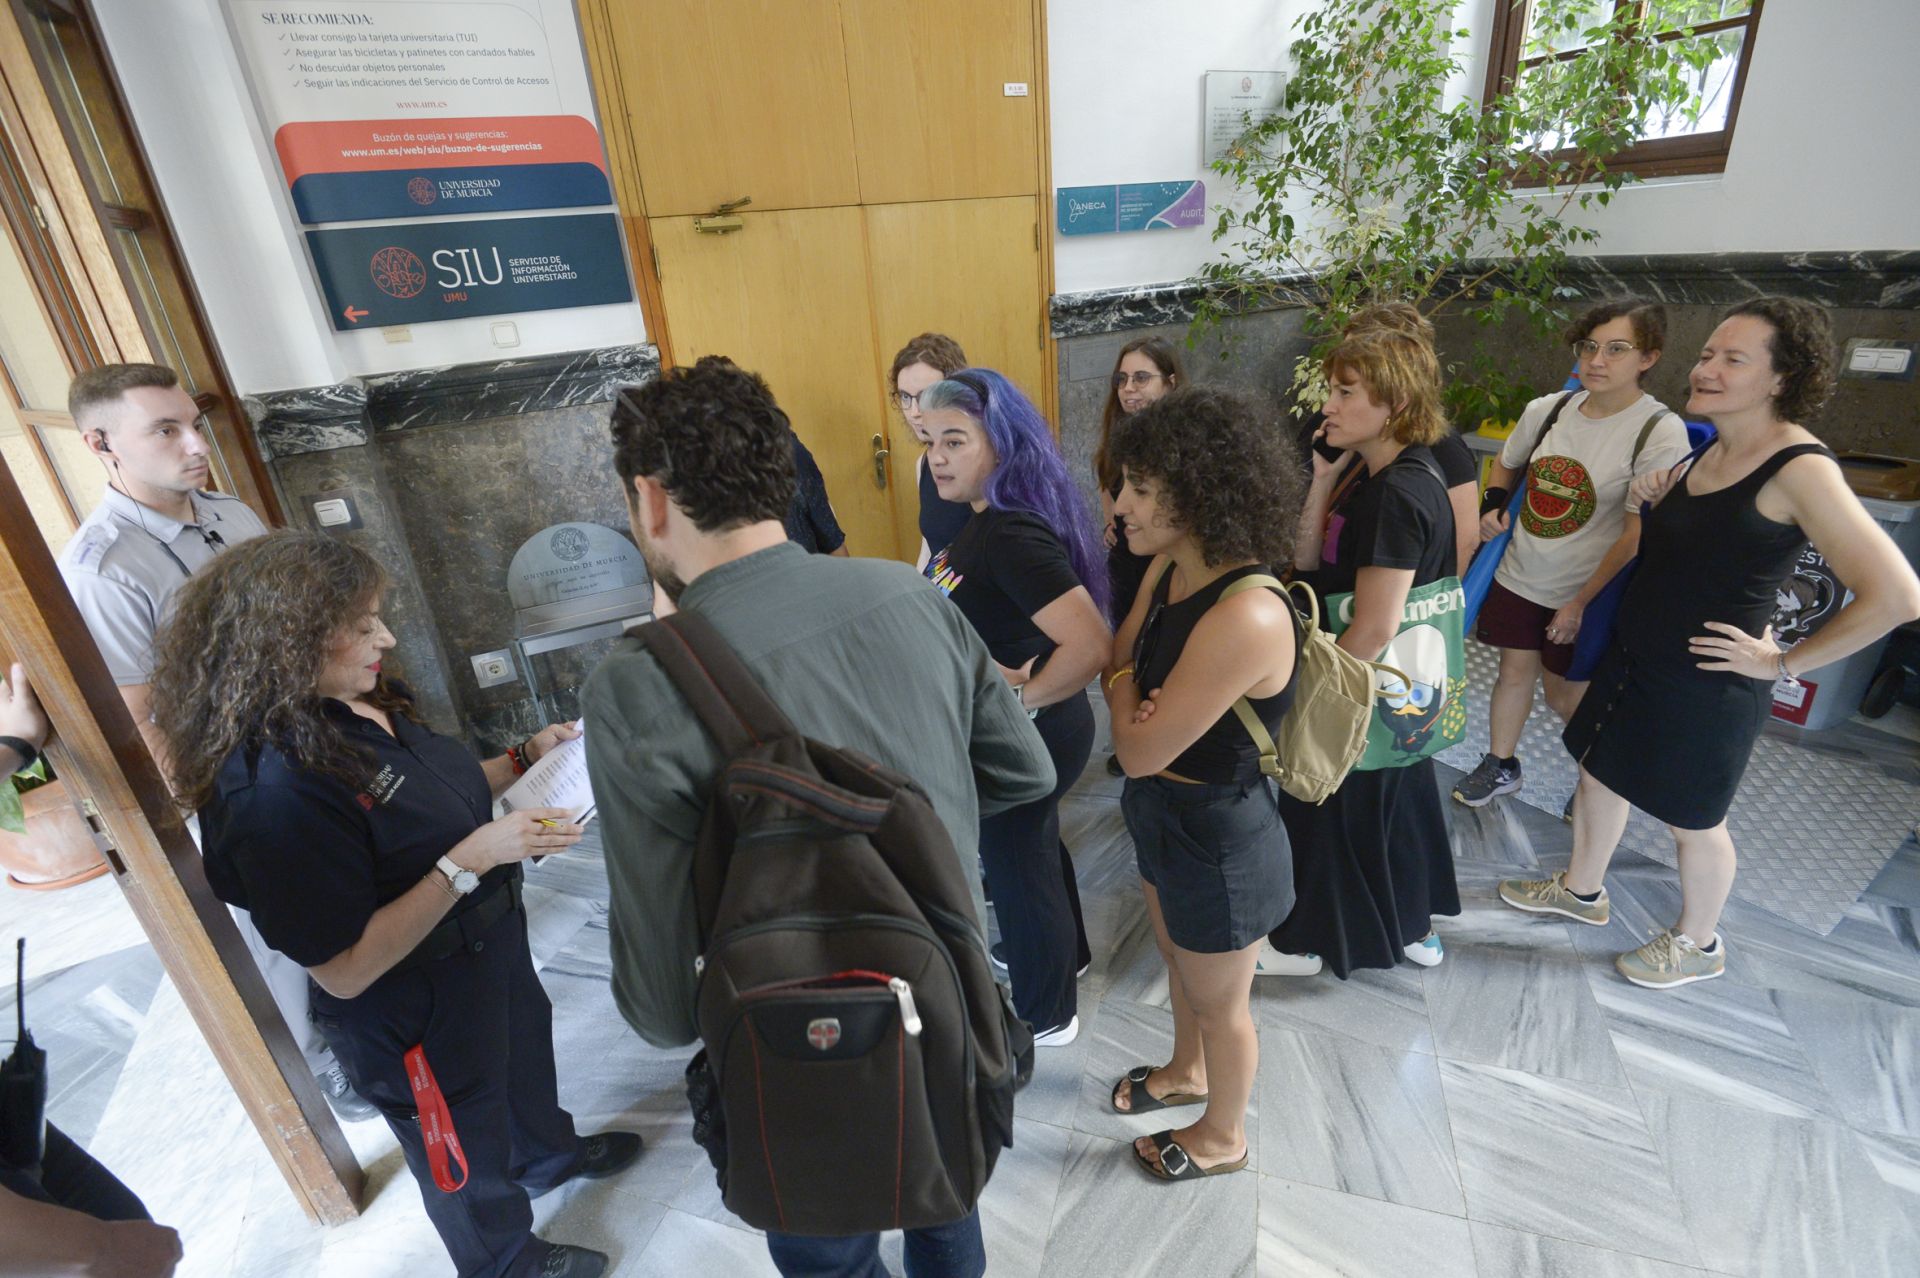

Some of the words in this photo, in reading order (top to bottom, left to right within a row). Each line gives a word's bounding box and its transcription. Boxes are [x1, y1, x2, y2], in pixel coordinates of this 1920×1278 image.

[261, 13, 280, 25] SE
[281, 13, 374, 26] RECOMIENDA:
[290, 33, 318, 42] Llevar
[321, 33, 357, 44] consigo
[358, 33, 368, 42] la
[369, 33, 399, 43] tarjeta
[400, 33, 455, 42] universitaria
[456, 33, 478, 43] (TUI)
[295, 48, 337, 58] Asegurar
[339, 48, 353, 57] las
[354, 48, 398, 57] bicicletas
[400, 49, 405, 58] y
[406, 48, 447, 58] patinetes
[449, 49, 465, 57] con
[466, 48, 507, 57] candados
[508, 48, 535, 57] fiables
[300, 63, 313, 73] No
[315, 63, 360, 73] descuidar
[362, 63, 396, 74] objetos
[398, 62, 446, 73] personales
[304, 79, 334, 90] Seguir
[336, 78, 350, 88] las
[351, 78, 407, 88] indicaciones
[408, 77, 423, 87] del
[424, 77, 459, 87] Servicio
[460, 77, 471, 86] de
[472, 76, 503, 86] Control
[504, 76, 515, 85] de
[516, 76, 550, 85] Accesos
[372, 132, 401, 143] Buzón
[403, 132, 415, 142] de
[416, 132, 446, 143] quejas
[448, 133, 453, 142] y
[454, 131, 509, 141] sugerencias:
[341, 142, 543, 158] www.um.es/web/siu/buzon-de-sugerencias
[439, 178, 501, 190] UNIVERSIDAD
[441, 190, 455, 199] DE
[456, 188, 493, 199] MURCIA
[1075, 201, 1107, 211] ANECA
[508, 256, 549, 266] SERVICIO
[550, 256, 562, 265] DE
[432, 246, 504, 289] SIU
[511, 263, 571, 275] INFORMACIÓN
[513, 271, 578, 284] UNIVERSITARIO
[444, 292, 469, 304] UMU
[522, 565, 580, 581] UNIVERSIDAD
[596, 555, 628, 566] MURCIA
